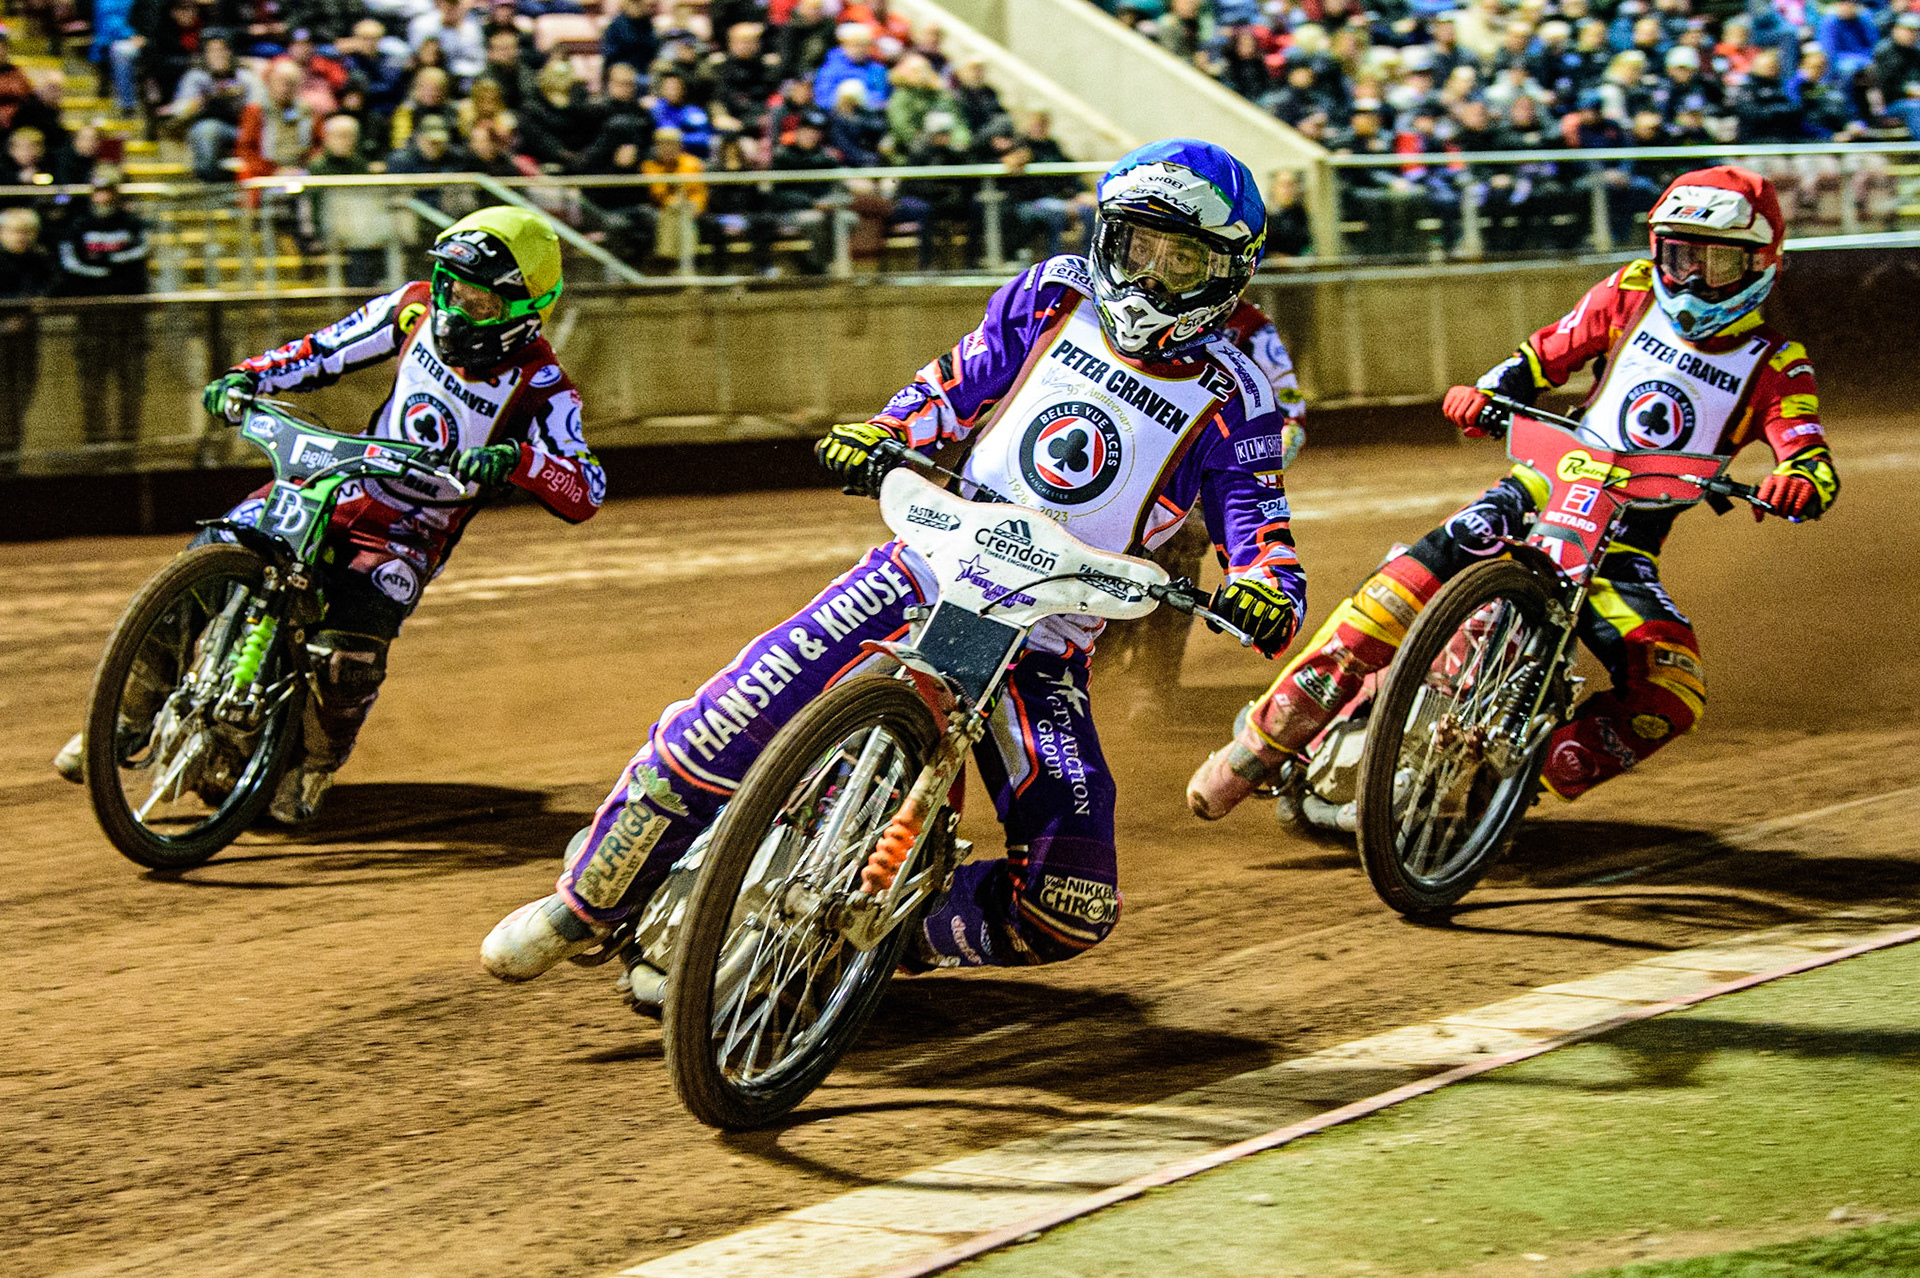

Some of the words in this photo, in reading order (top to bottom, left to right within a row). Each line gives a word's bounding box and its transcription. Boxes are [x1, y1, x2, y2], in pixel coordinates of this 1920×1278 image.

[1633, 331, 1678, 364] PETER
[1677, 353, 1742, 395] CRAVEN
[1748, 335, 1769, 356] 7
[411, 341, 446, 383] PETER
[443, 374, 499, 419] CRAVEN
[1050, 339, 1111, 384] PETER
[1105, 369, 1190, 435] CRAVEN
[1198, 363, 1237, 402] 12
[1085, 387, 1134, 433] Anniversary
[1662, 384, 1681, 400] VUE
[1682, 402, 1695, 427] ACES
[1039, 404, 1080, 424] BELLE
[1085, 406, 1108, 429] VUE
[1104, 432, 1119, 467] ACES
[300, 450, 339, 469] agilia
[541, 465, 584, 503] agilia
[1027, 472, 1069, 500] MANCHESTER
[909, 504, 952, 522] FASTRACK
[1545, 511, 1597, 532] BETARD
[975, 528, 1056, 571] Crendon
[1006, 557, 1049, 577] ENGINEERING
[1079, 564, 1133, 592] FASRACK
[682, 644, 802, 762] HANSEN
[789, 627, 829, 661] &
[811, 561, 912, 643] KRUSE
[1037, 719, 1063, 779] GROUP
[1046, 695, 1072, 732] CTY
[1060, 732, 1090, 816] AUCTION
